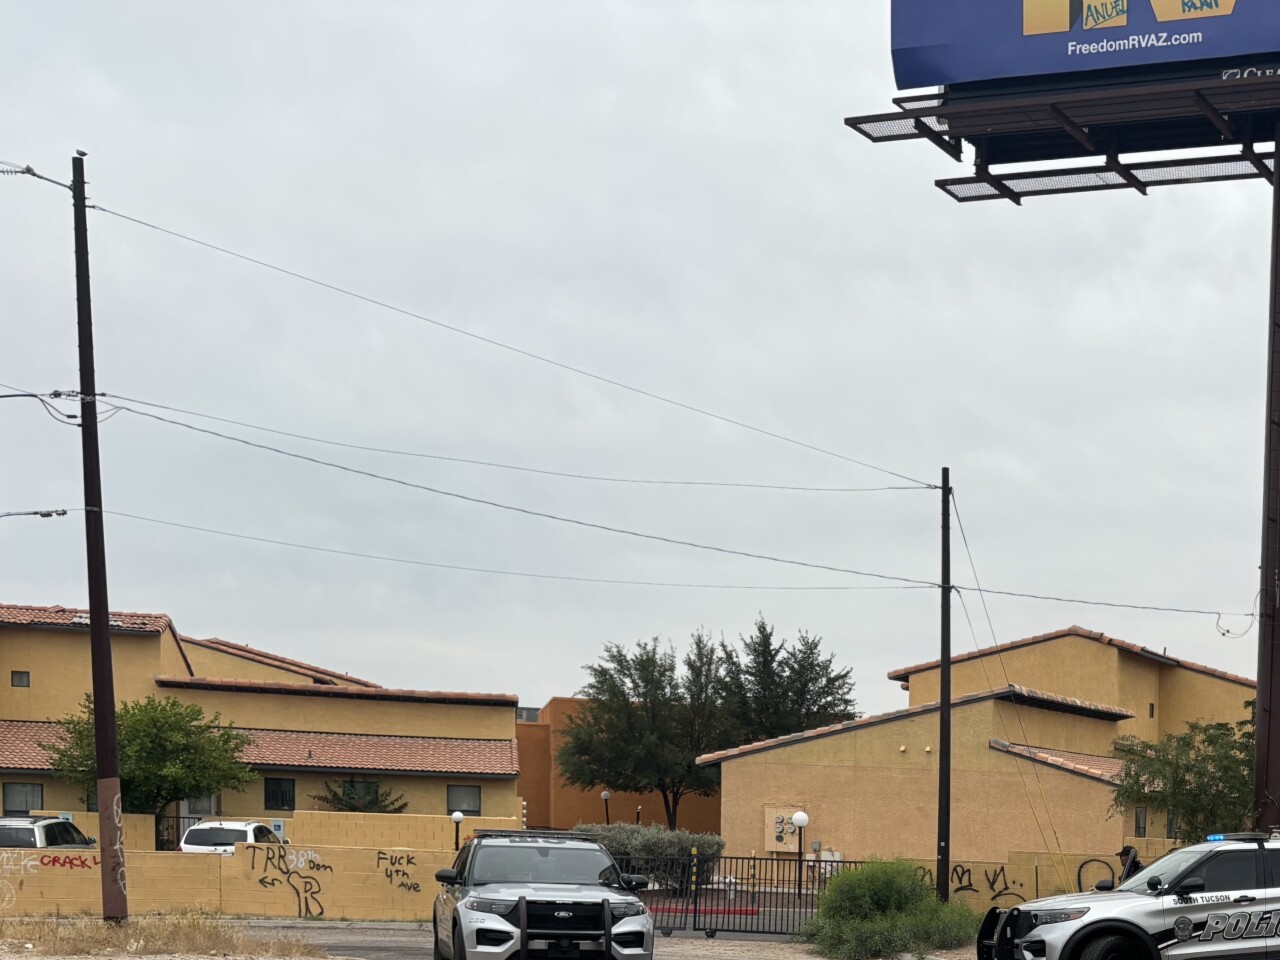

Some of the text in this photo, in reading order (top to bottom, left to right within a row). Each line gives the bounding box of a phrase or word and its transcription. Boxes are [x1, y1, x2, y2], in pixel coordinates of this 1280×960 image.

[1067, 31, 1203, 55] FreedomRVAZ.com
[40, 854, 92, 869] CRACK
[1172, 894, 1231, 905] SOUTH TUCSON
